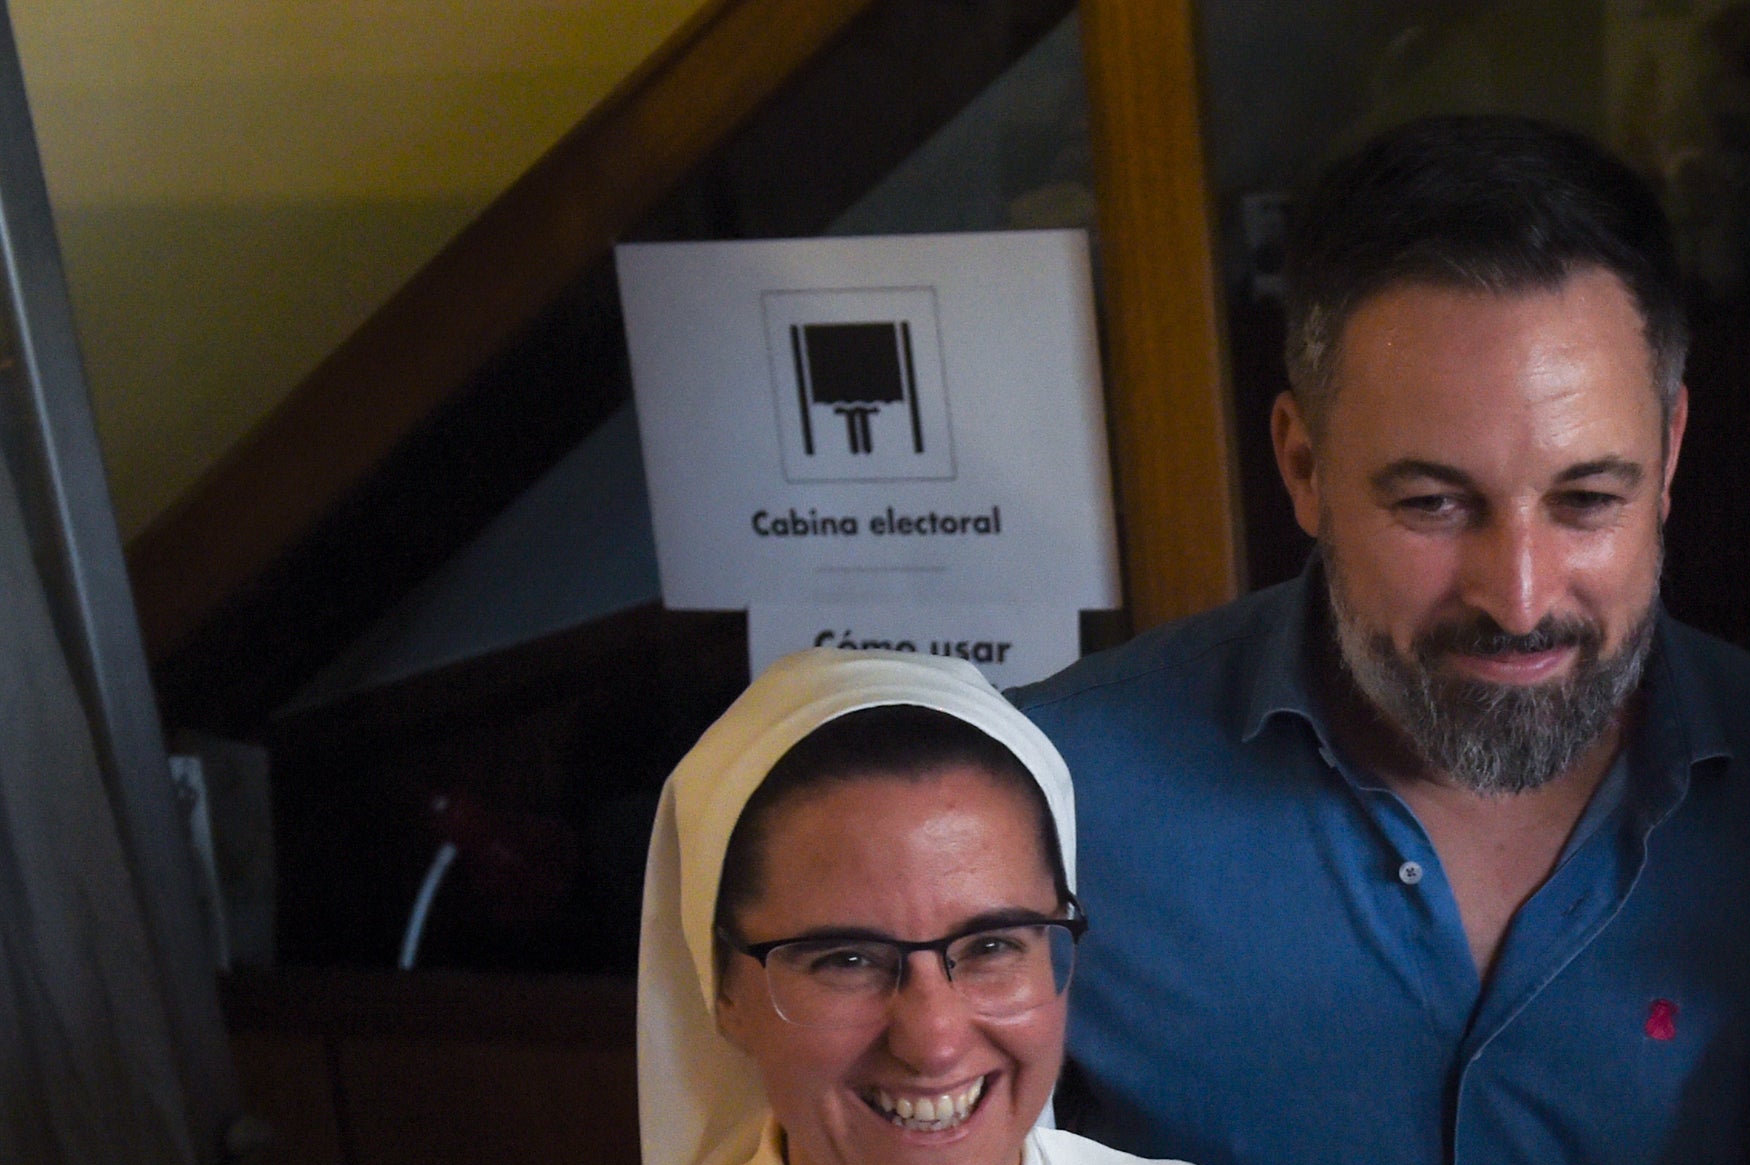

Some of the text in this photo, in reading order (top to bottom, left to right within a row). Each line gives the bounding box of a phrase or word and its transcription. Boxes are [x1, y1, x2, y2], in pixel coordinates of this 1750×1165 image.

[752, 505, 1002, 537] Cabina electoral
[930, 639, 1012, 664] usar
